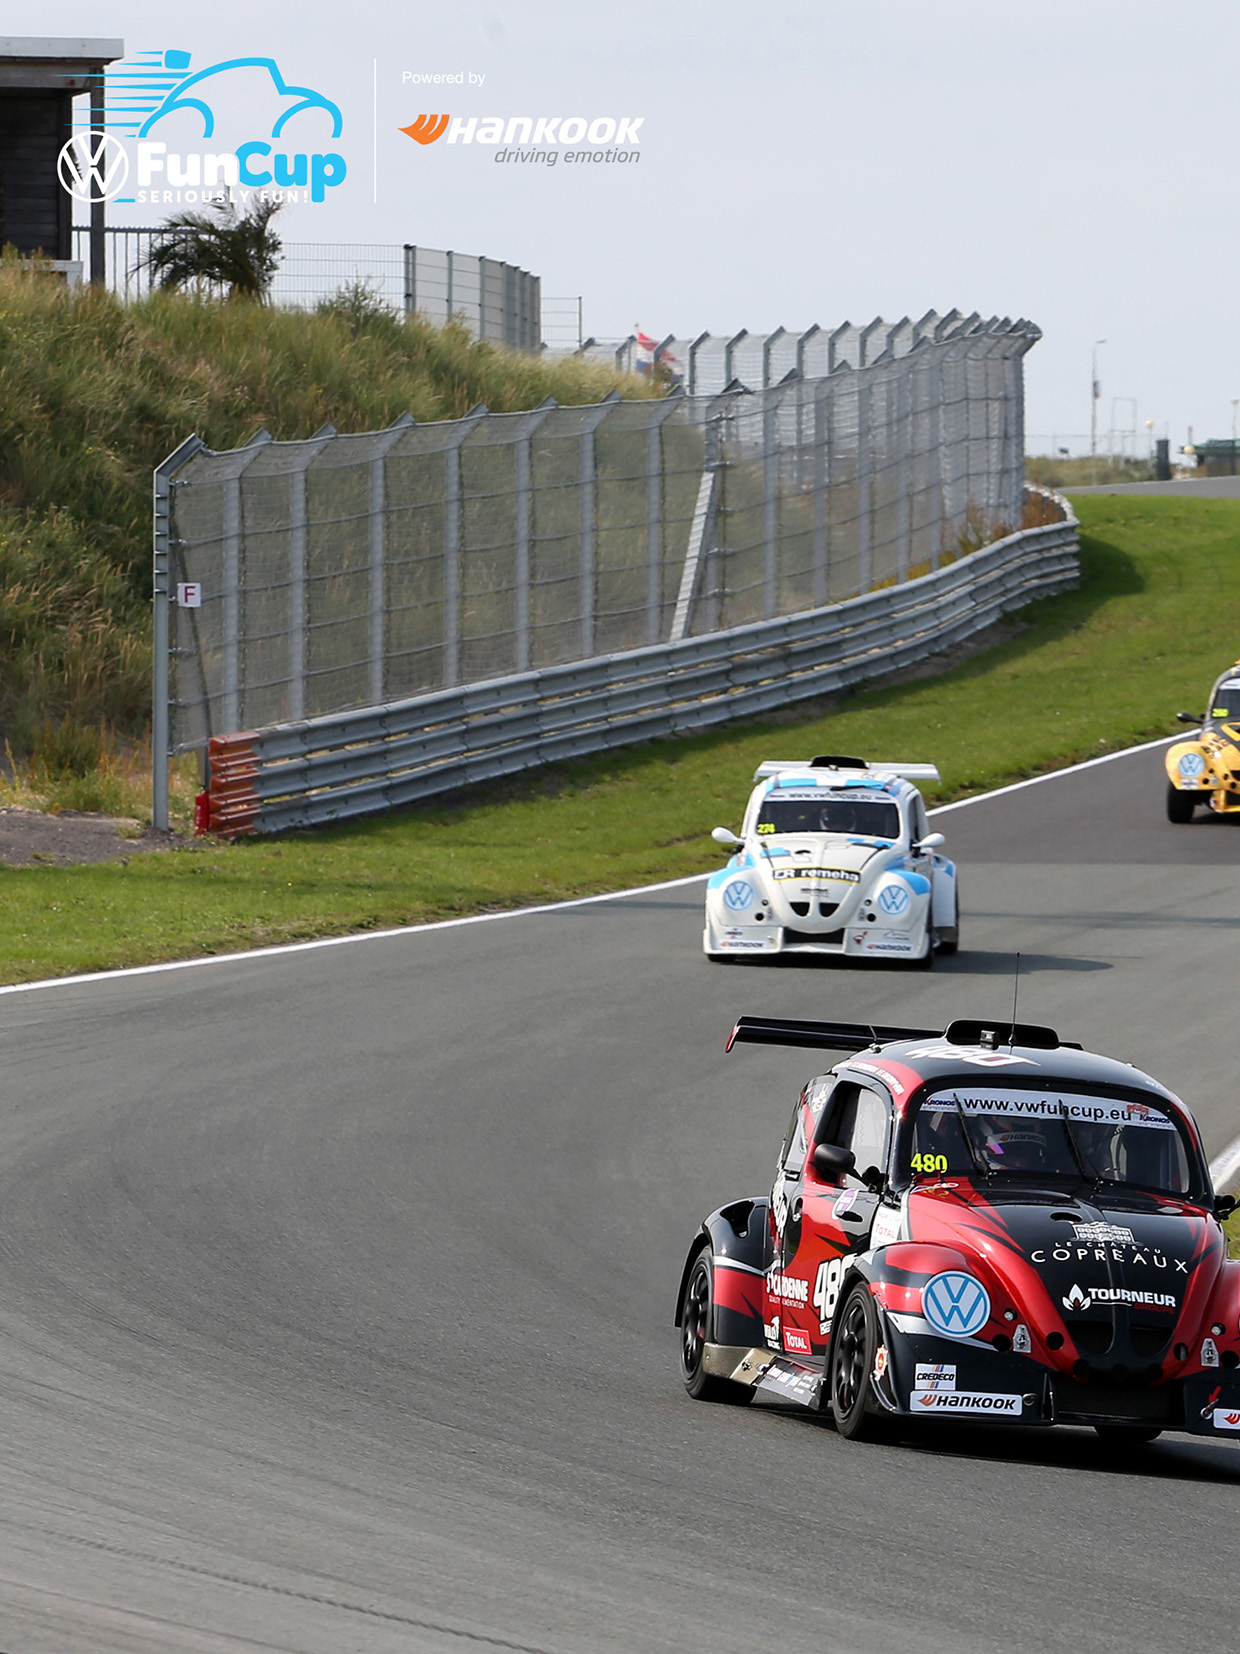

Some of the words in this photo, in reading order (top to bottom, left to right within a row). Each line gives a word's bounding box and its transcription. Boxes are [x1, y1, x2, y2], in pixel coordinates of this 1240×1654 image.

[184, 585, 196, 603] F
[800, 868, 859, 882] remeha
[963, 1097, 1132, 1122] www.vwfuncup.eu
[910, 1153, 948, 1174] 480
[1030, 1248, 1189, 1274] COPREAUX
[1087, 1287, 1177, 1308] TOURNEUR
[916, 1372, 955, 1382] CREDECO
